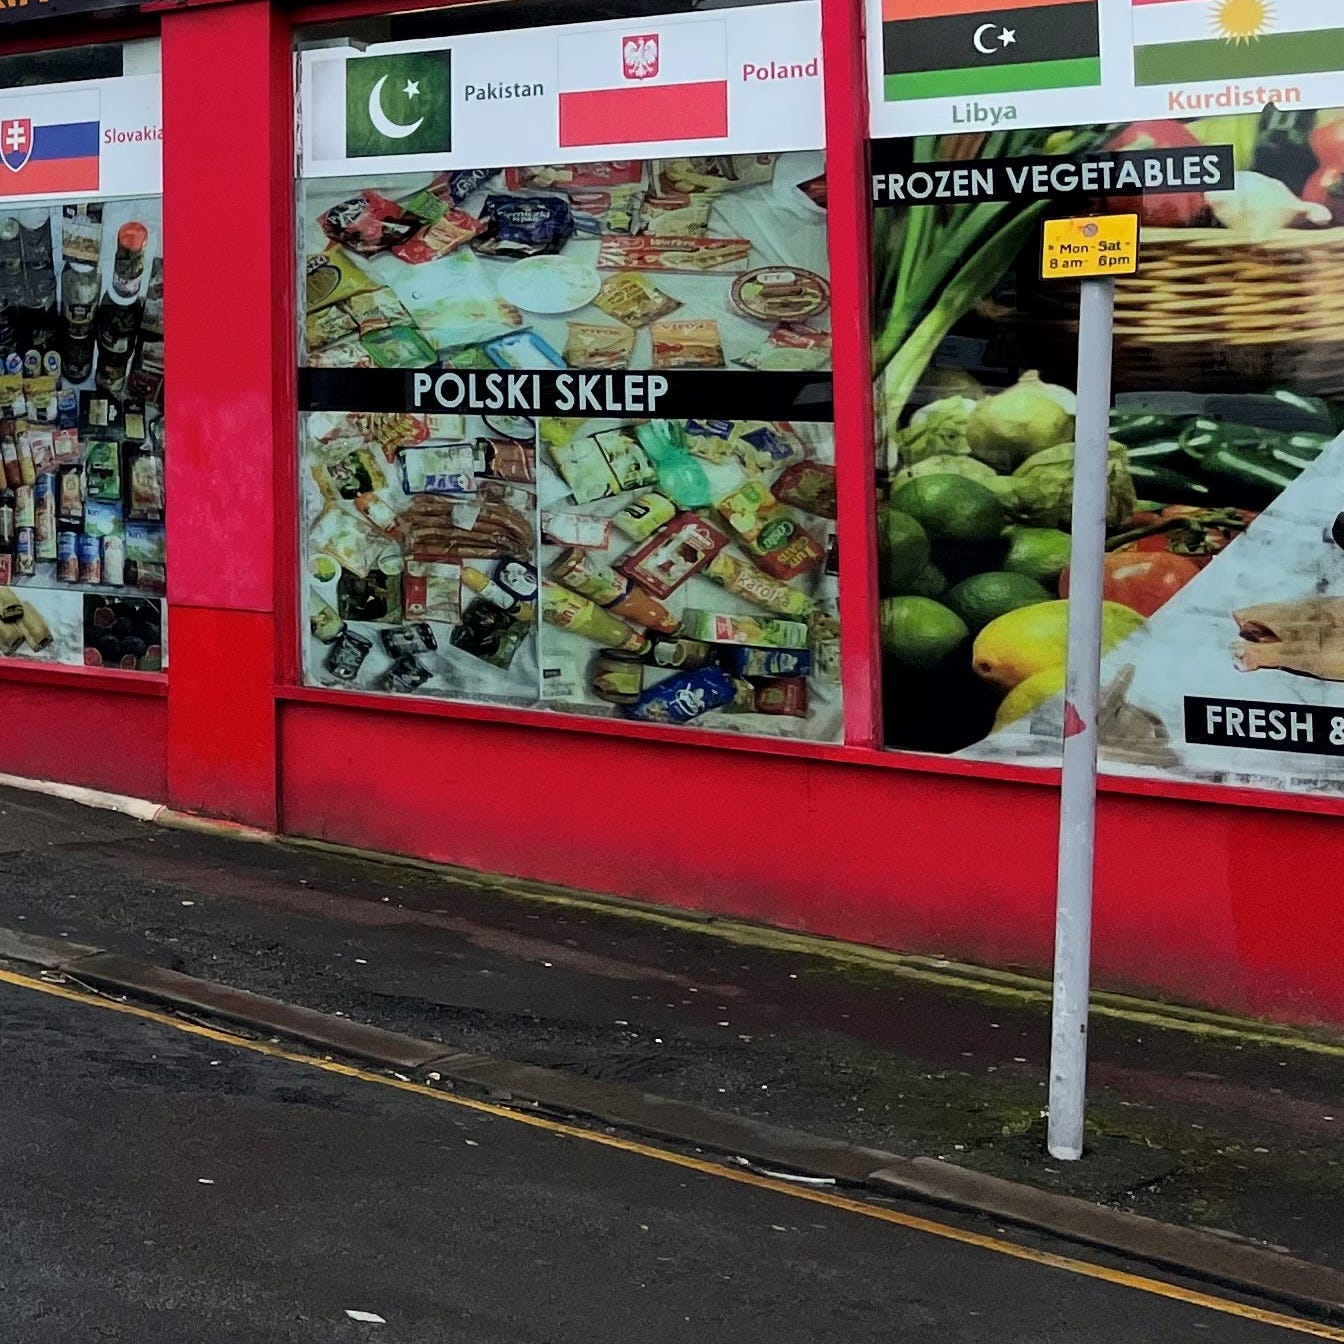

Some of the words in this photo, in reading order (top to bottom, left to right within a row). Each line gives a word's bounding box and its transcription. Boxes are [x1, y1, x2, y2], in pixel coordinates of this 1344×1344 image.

[742, 60, 820, 82] Poland
[464, 80, 544, 102] Pakistan
[1167, 84, 1302, 111] Kurdistan
[951, 101, 1018, 127] Libya
[103, 124, 164, 144] Slovakia
[871, 167, 994, 201] FROZEN
[1006, 155, 1222, 195] VEGETABLES
[1059, 243, 1089, 254] Mon
[1097, 239, 1121, 252] Sat
[413, 372, 541, 410] POLSKI
[554, 373, 669, 412] SKLEP
[1206, 704, 1314, 743] FRESH
[1328, 715, 1344, 746] &
